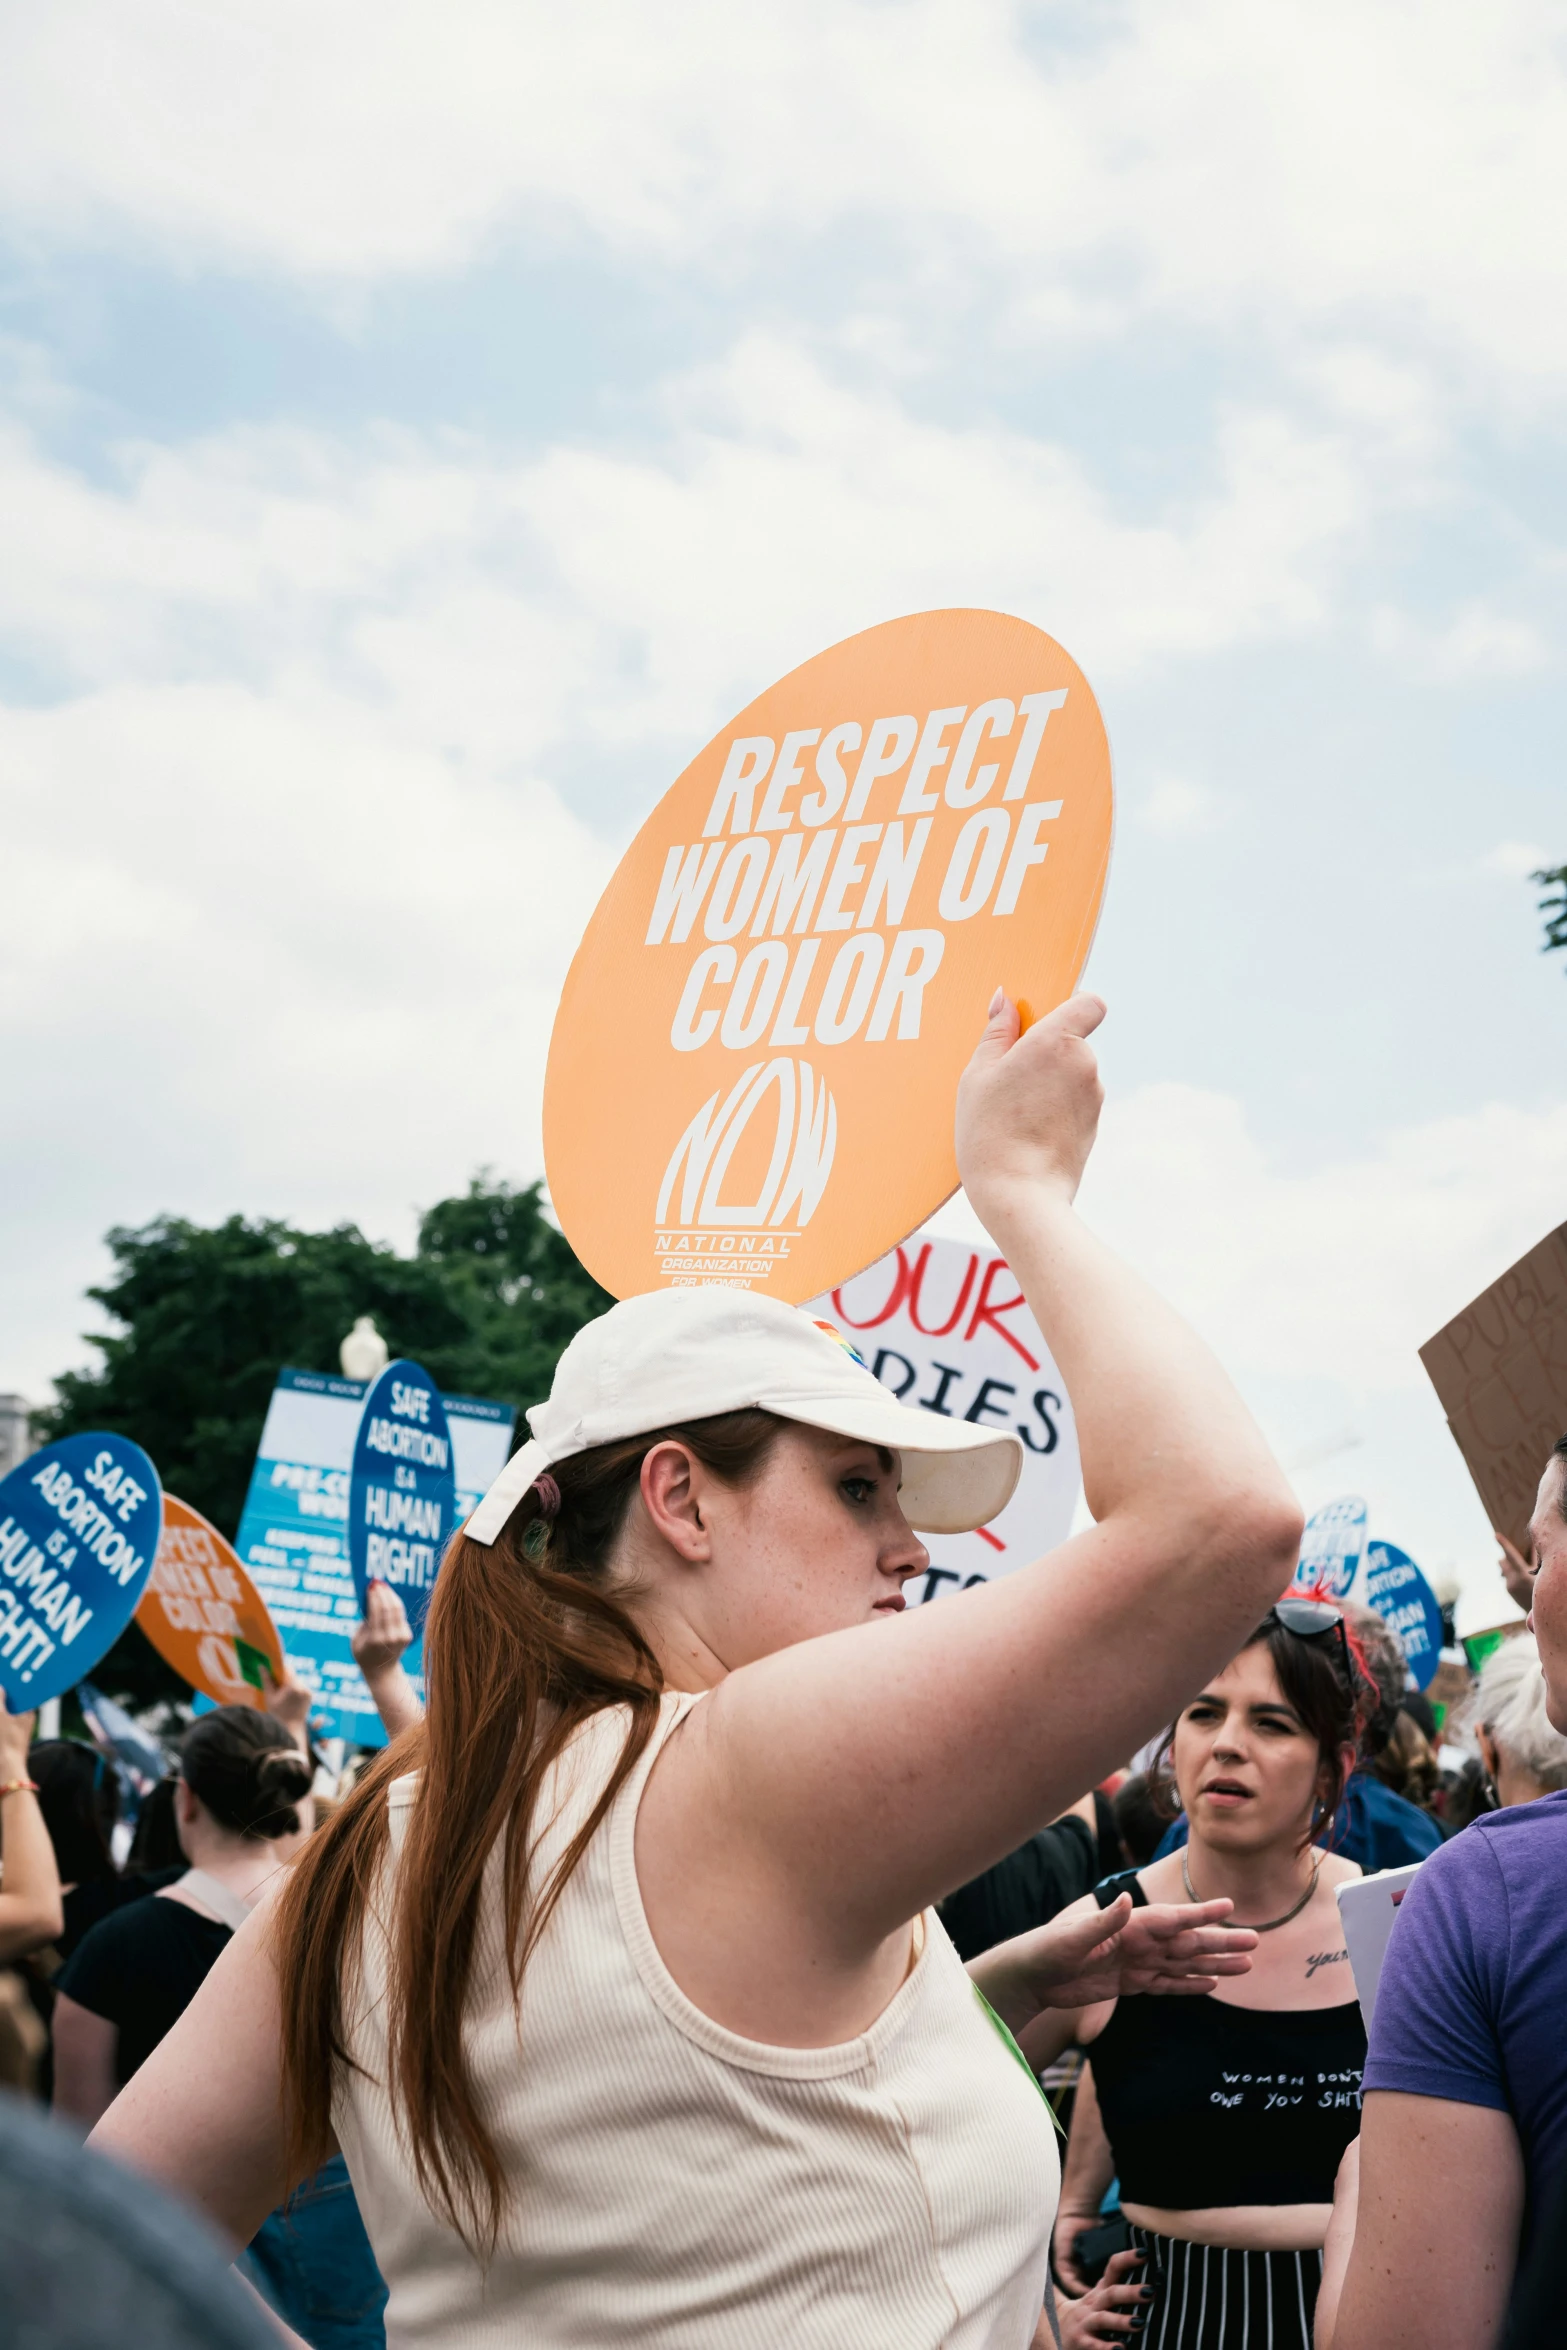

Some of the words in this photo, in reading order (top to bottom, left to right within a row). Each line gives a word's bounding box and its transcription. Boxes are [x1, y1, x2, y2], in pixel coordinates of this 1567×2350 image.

[702, 688, 1069, 838] RESPECT
[644, 816, 934, 945] WOMEN
[938, 799, 1064, 922] OF
[670, 928, 945, 1052] COLOR
[655, 1057, 838, 1227] NOW
[656, 1236, 791, 1253] NATIONAL
[661, 1257, 773, 1272] ORGANIZATION
[671, 1277, 698, 1288] FOR
[702, 1278, 752, 1289] WOMEN
[831, 1242, 1040, 1372] OUR
[390, 1380, 432, 1424] SAFE
[851, 1345, 1062, 1455] DIES
[366, 1416, 450, 1470] ABORTION
[84, 1450, 147, 1522] SAFE
[365, 1485, 441, 1541] HUMAN
[31, 1461, 144, 1586] ABORTION
[45, 1528, 69, 1556] IS
[57, 1547, 78, 1570] A
[0, 1516, 93, 1646] HUMAN
[365, 1533, 434, 1588] RIGHT!
[0, 1588, 56, 1683] GHT!
[1209, 2091, 1245, 2108] OWE
[1263, 2092, 1304, 2110] YOU
[1317, 2089, 1363, 2110] SHIT
[1221, 2071, 1304, 2086] WOMEN
[1317, 2068, 1363, 2084] DON'T
